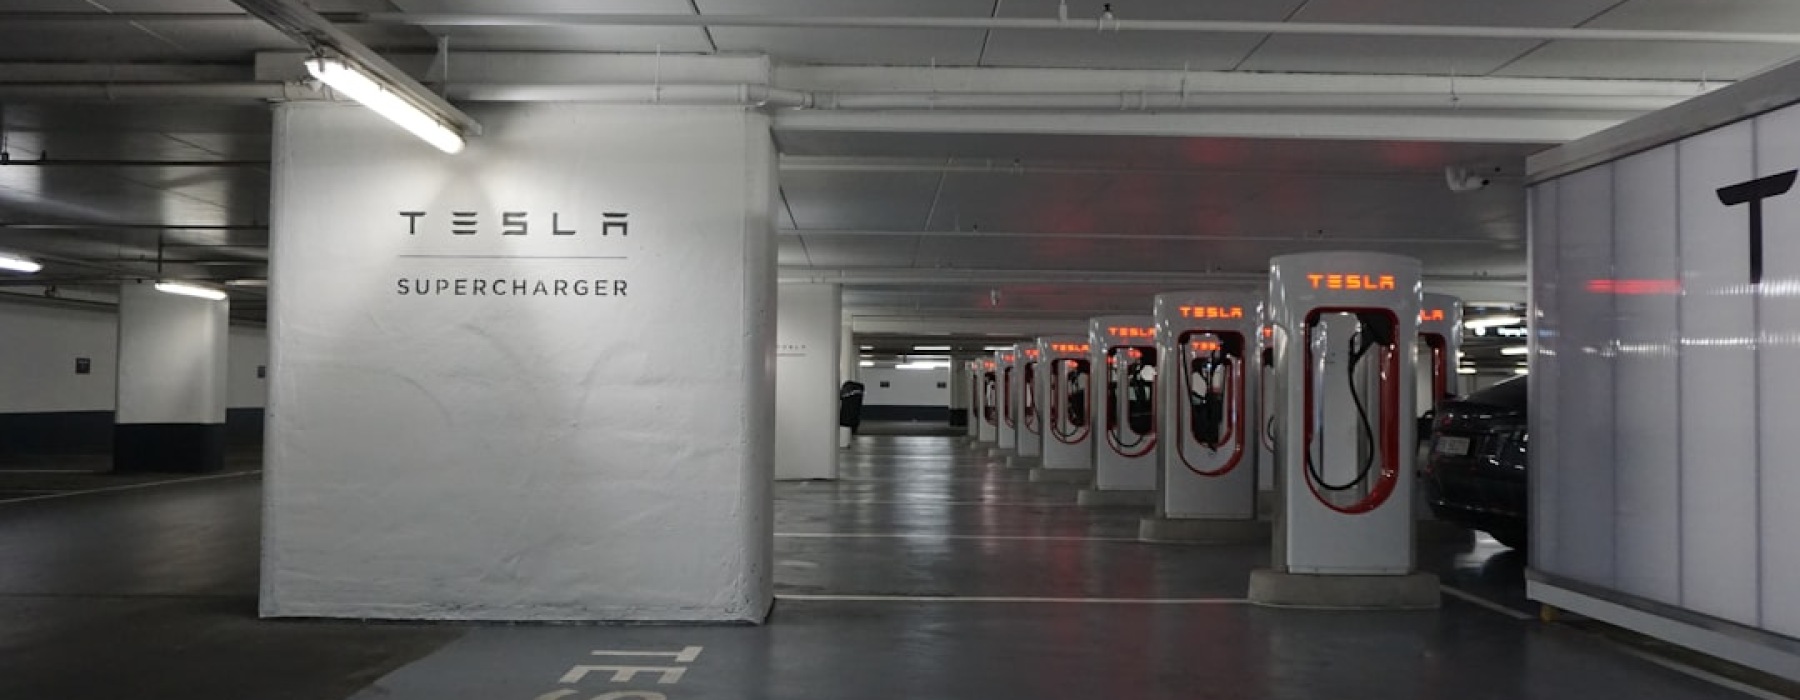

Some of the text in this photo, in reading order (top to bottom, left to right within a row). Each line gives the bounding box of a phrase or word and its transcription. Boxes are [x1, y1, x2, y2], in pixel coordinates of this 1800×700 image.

[398, 211, 629, 236] TESLA
[397, 277, 628, 296] SUPERCHARGER
[1306, 273, 1396, 291] TESLA
[1179, 305, 1244, 319] TESLA
[1107, 326, 1157, 338] TESLA
